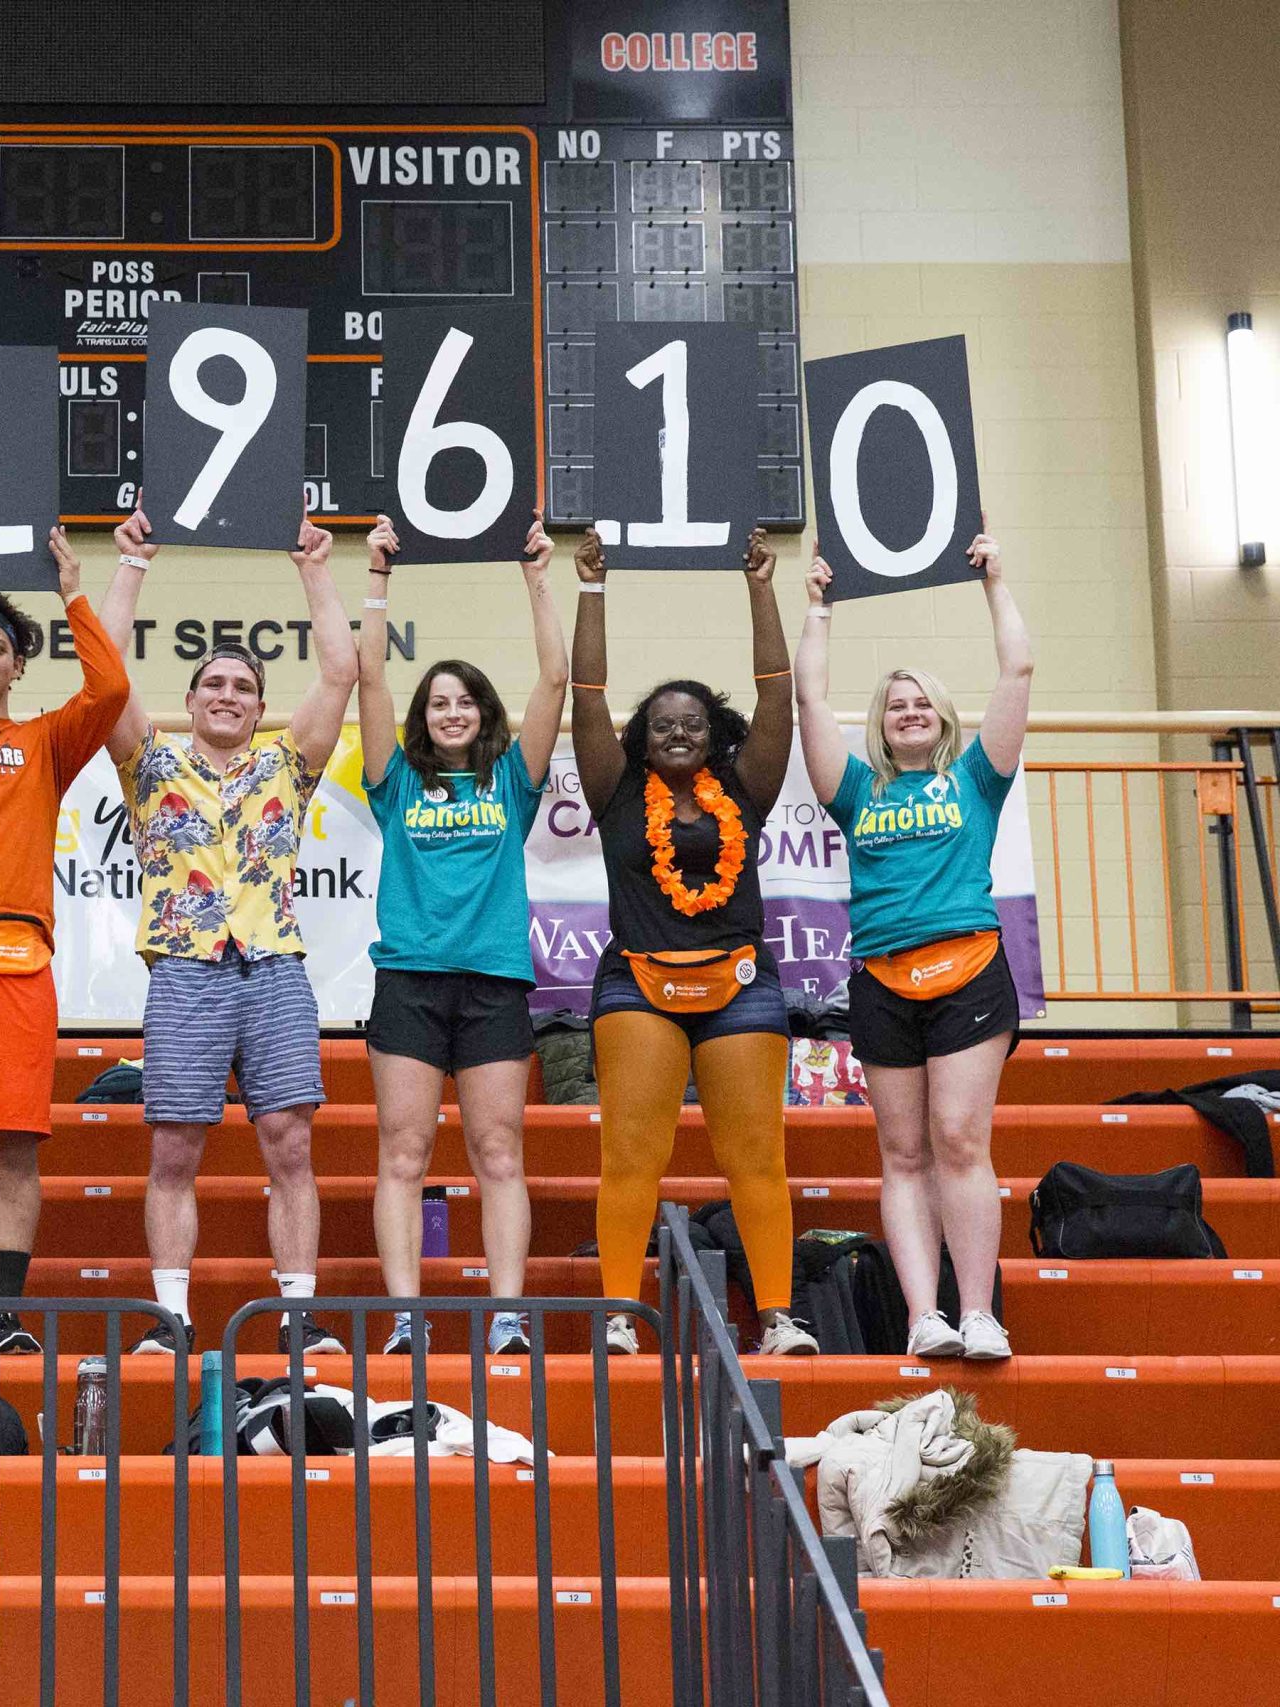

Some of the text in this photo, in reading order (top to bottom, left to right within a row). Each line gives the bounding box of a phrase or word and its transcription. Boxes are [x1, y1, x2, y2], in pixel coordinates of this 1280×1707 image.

[600, 31, 758, 72] COLLEGE
[347, 145, 521, 186] VISITOR
[558, 130, 781, 160] NO F PTS
[92, 261, 155, 284] POSS
[168, 327, 277, 531] 9
[397, 326, 514, 540] 6
[829, 379, 958, 577] 0
[174, 619, 416, 661] SECTN
[405, 800, 507, 831] dancing
